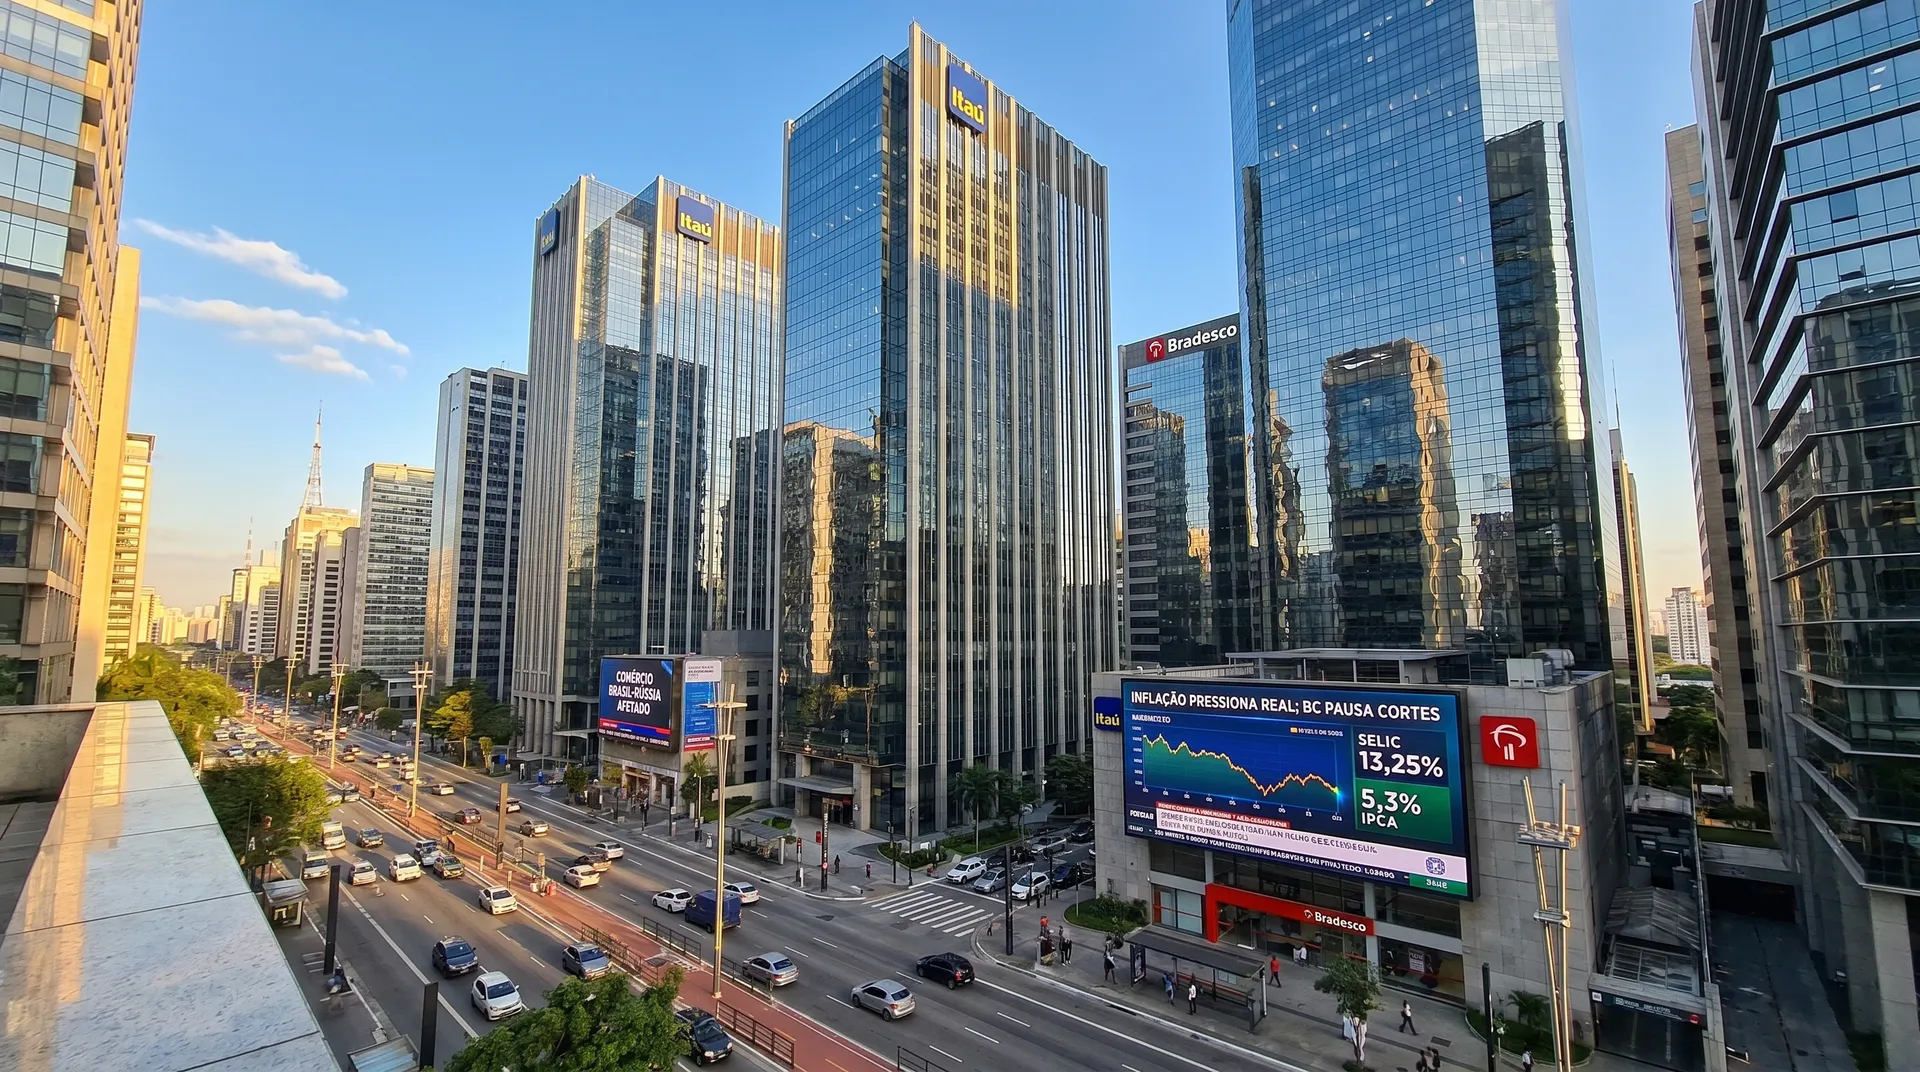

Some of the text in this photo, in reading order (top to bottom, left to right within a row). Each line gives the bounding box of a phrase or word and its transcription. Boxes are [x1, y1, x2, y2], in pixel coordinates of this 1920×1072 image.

[952, 86, 985, 125] Itaú
[679, 212, 712, 238] Itaú
[1167, 325, 1238, 353] Bradesco
[616, 669, 654, 685] COMÉRCIO
[608, 684, 662, 702] BRASIL-RÚSSIA
[616, 700, 651, 715] AFETADO
[1131, 691, 1441, 722] INFLAÇÃO PRESSIONA REAL; BC PAUSA CORTES
[1095, 712, 1120, 726] Itaú
[1358, 733, 1401, 749] SELIC
[1358, 750, 1444, 778] 13,25%
[1361, 788, 1422, 815] 5,3%
[1361, 812, 1399, 830] IPCA
[1314, 911, 1367, 932] Bradesco
